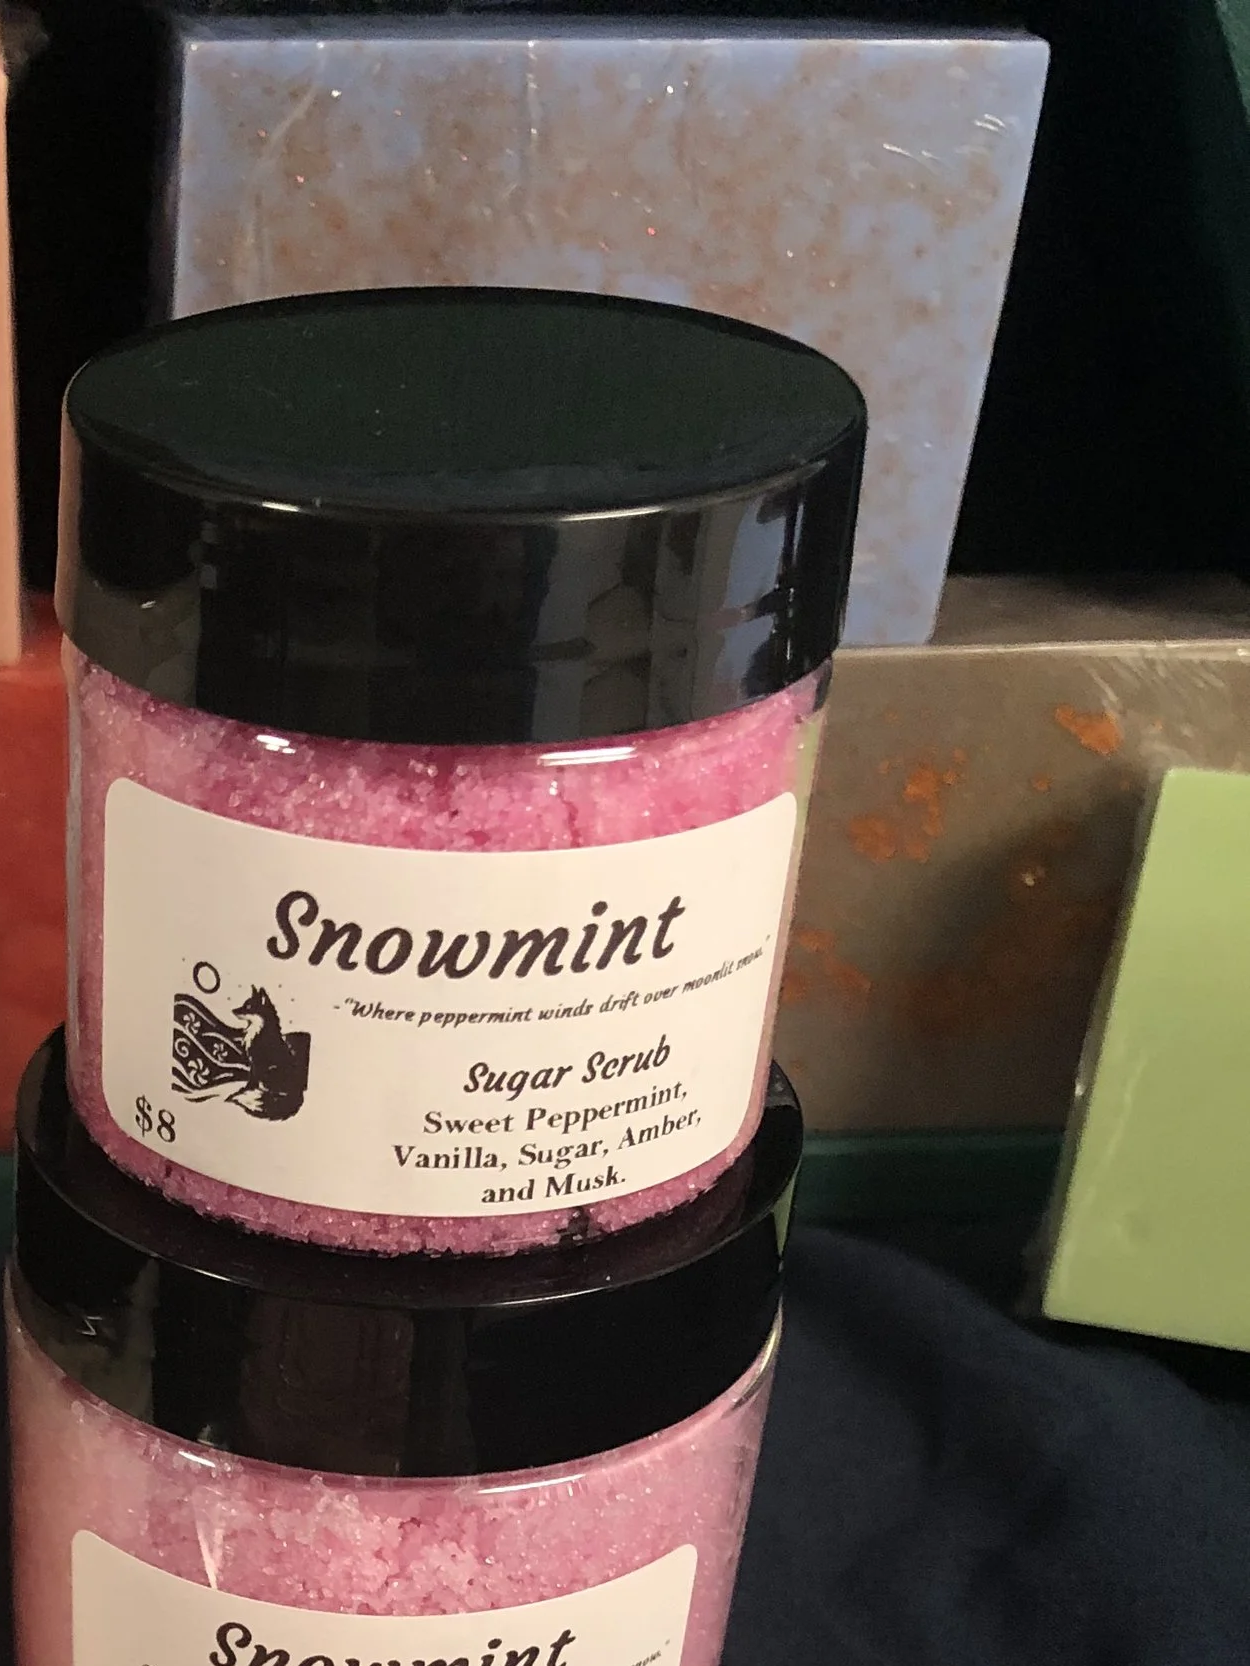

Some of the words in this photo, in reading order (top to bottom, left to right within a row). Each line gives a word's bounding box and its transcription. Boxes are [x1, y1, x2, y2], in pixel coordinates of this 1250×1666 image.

[267, 890, 686, 979] Snowmint
[334, 998, 413, 1022] -"Where
[418, 1006, 532, 1028] peppermint
[538, 998, 594, 1020] winds
[599, 990, 639, 1013] drift
[644, 986, 678, 1004] over
[682, 960, 733, 994] moonlit
[463, 1062, 572, 1102] Sugar
[581, 1034, 670, 1083] Scrub
[135, 1094, 176, 1143] $8
[393, 1145, 508, 1171] Vanilla,
[518, 1139, 610, 1169] Sugar,
[617, 1107, 701, 1149] Amber,
[423, 1111, 515, 1134] Sweet
[526, 1080, 688, 1134] Peppermint,
[481, 1179, 535, 1203] and
[545, 1166, 626, 1198] Musk.
